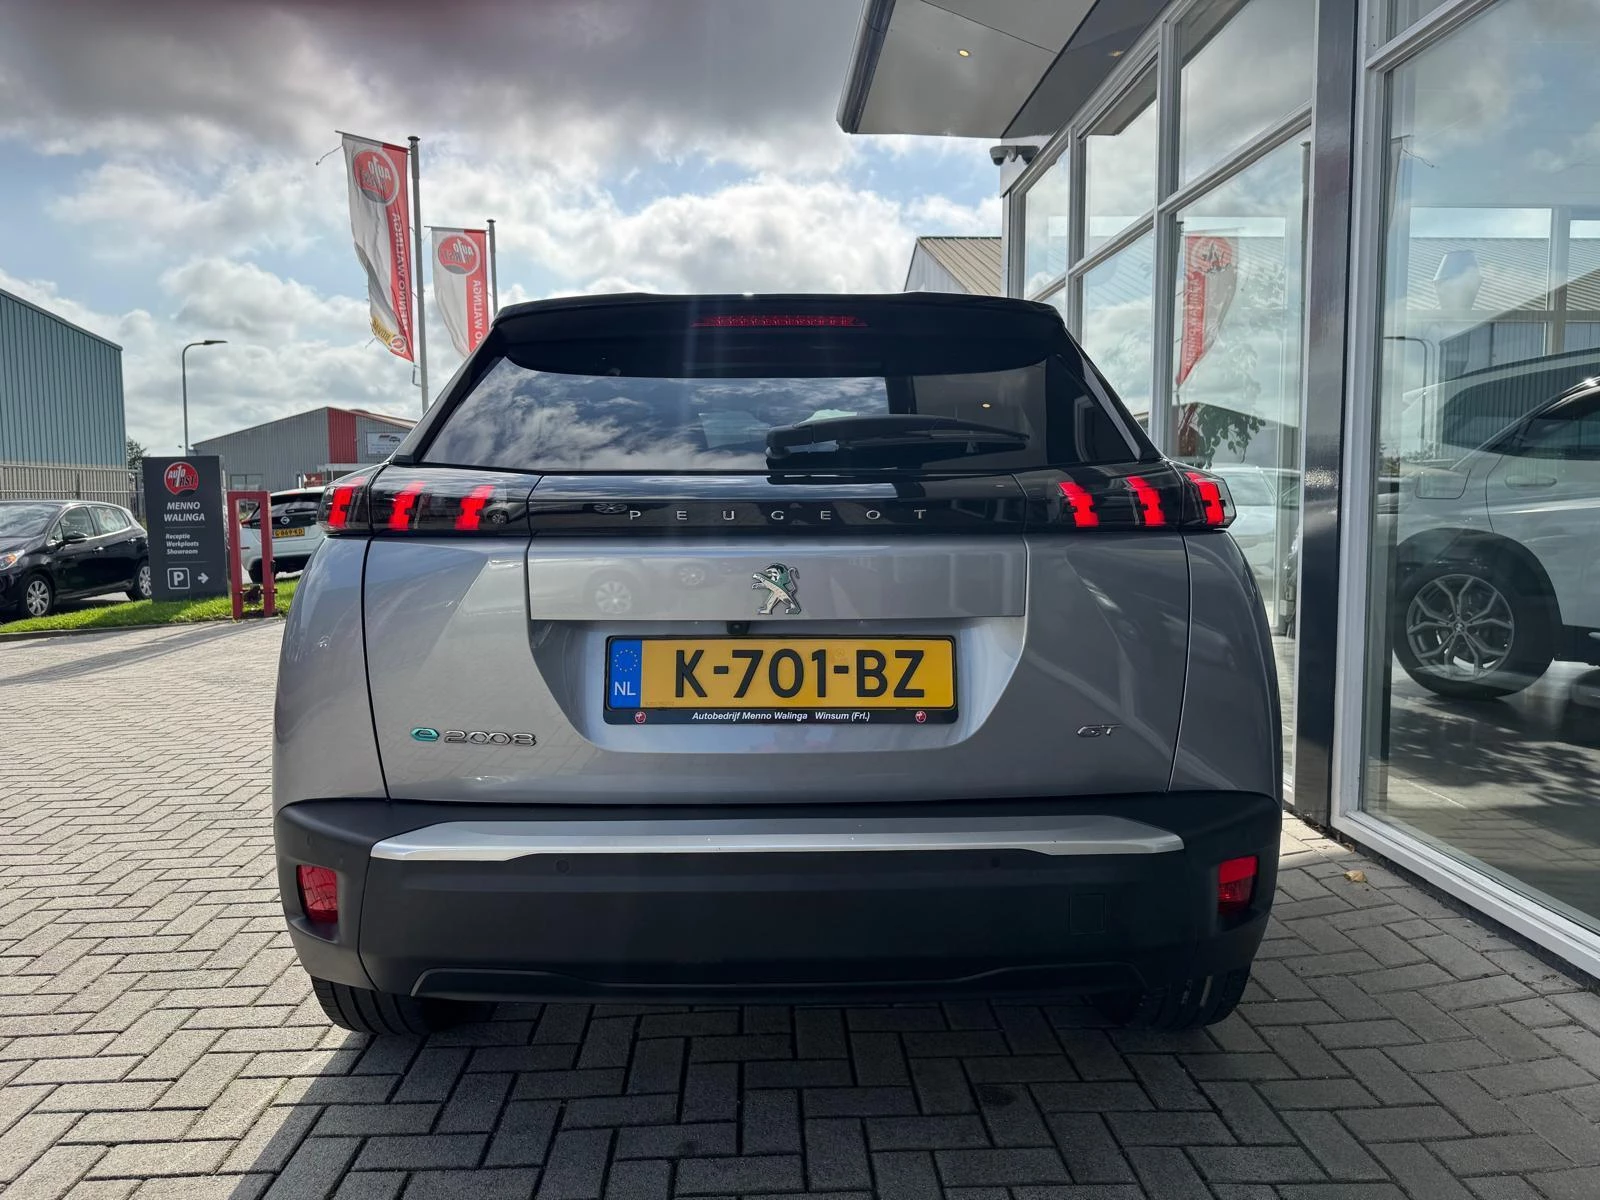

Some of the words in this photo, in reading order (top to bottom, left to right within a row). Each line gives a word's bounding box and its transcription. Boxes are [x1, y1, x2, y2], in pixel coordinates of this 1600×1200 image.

[167, 502, 200, 511] MENNO
[164, 513, 205, 522] WALINGA
[629, 509, 927, 521] PEUGEOT
[173, 571, 184, 586] P
[675, 649, 925, 698] K-701-BZ
[614, 681, 636, 696] NL
[692, 711, 740, 721] Autobedrijf
[742, 711, 772, 720] Menno
[774, 711, 808, 722] Walinga
[815, 711, 849, 720] Winsum
[851, 711, 870, 722] (Frl.)
[1077, 724, 1121, 737] GT
